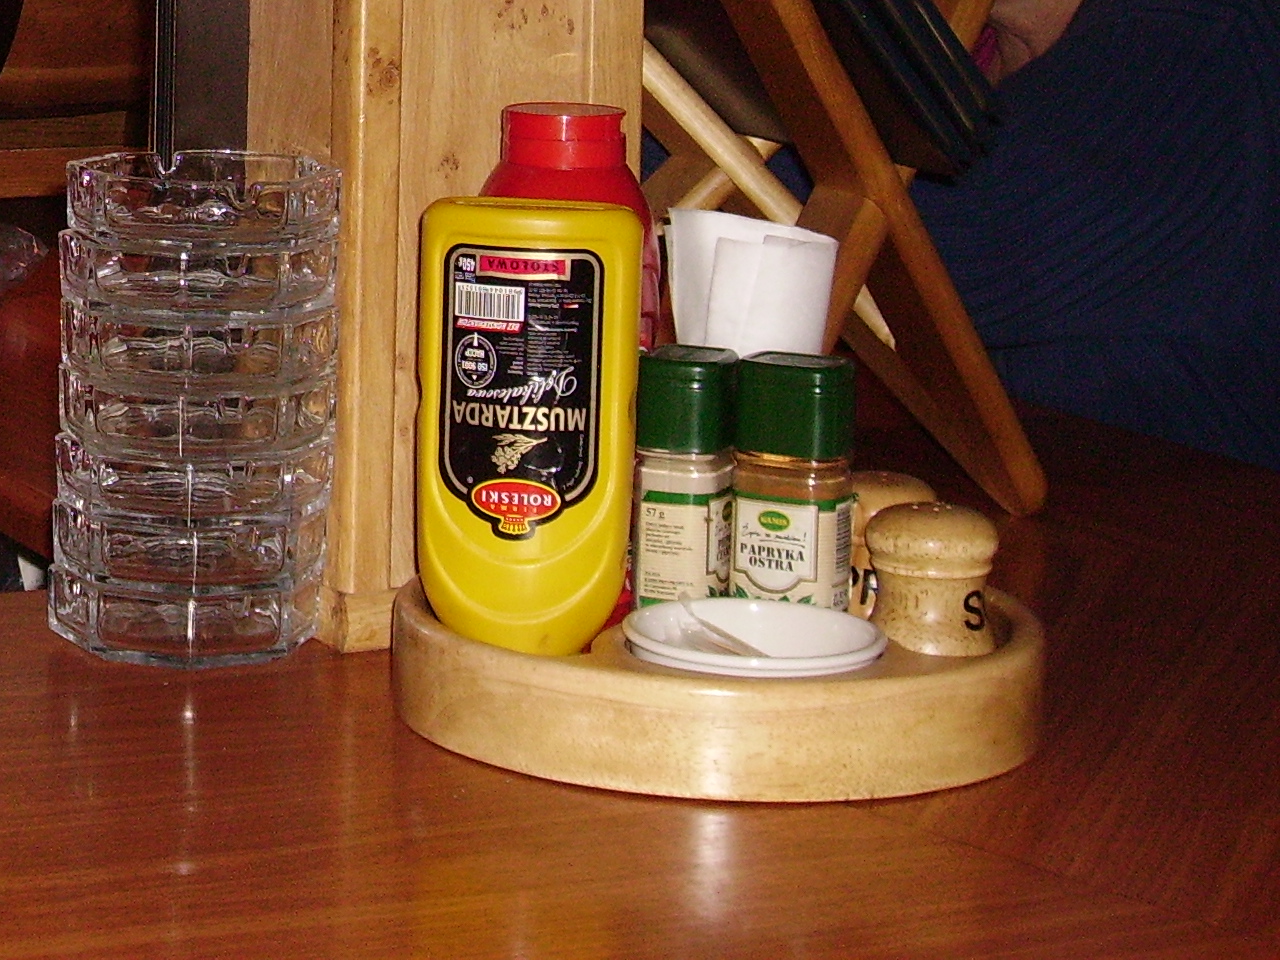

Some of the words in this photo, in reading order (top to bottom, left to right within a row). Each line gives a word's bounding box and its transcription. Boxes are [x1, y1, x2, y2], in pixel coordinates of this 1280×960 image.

[452, 400, 587, 432] MUSZTARDA
[481, 489, 552, 507] ROLESKI
[645, 508, 657, 518] 57
[740, 542, 805, 562] PAPRYKA
[749, 555, 794, 573] OSTRA
[963, 589, 985, 632] S
